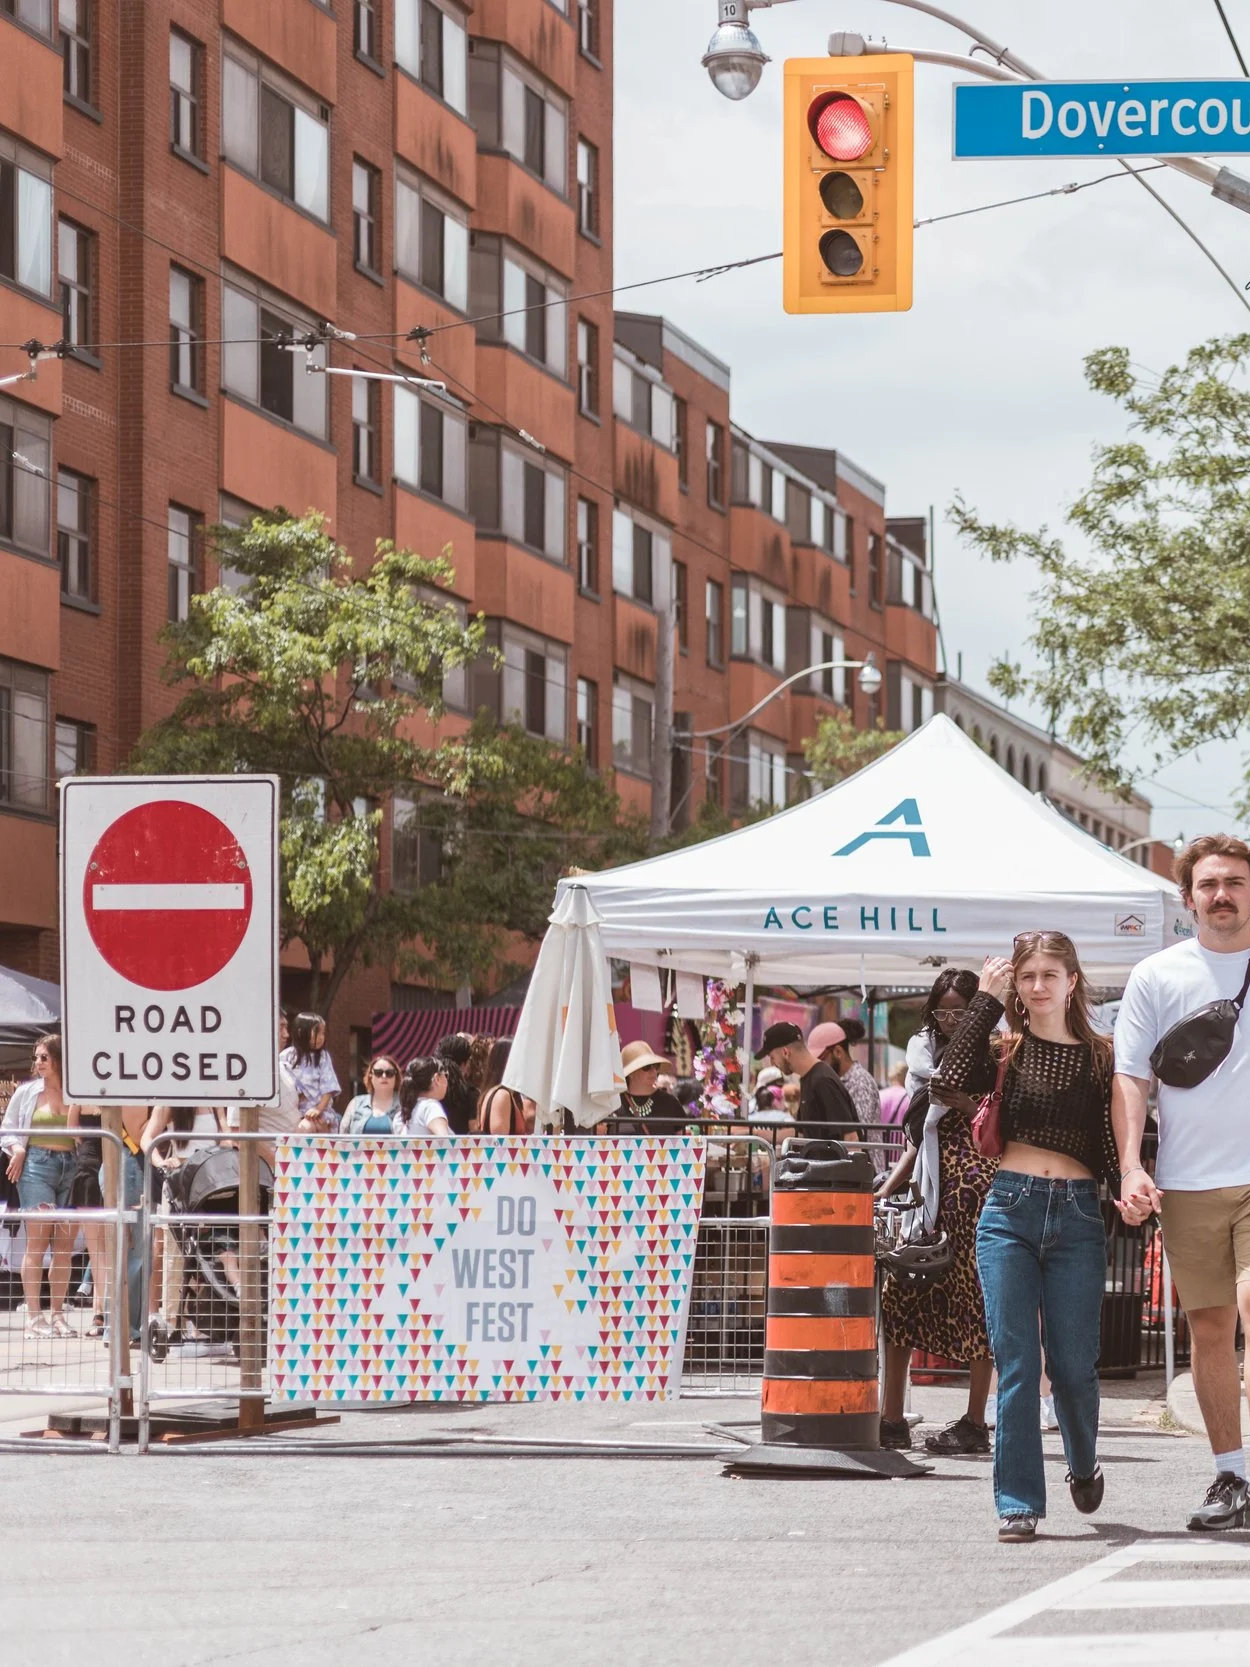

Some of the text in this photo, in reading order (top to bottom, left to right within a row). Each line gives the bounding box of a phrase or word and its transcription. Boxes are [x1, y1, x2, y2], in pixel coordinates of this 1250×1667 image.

[724, 4, 736, 16] 10
[764, 905, 948, 933] ACE HILL
[115, 1004, 223, 1034] ROAD
[92, 1052, 249, 1082] CLOSED
[497, 1195, 537, 1237] DO
[451, 1249, 534, 1290] WEST
[465, 1301, 534, 1343] FEST
